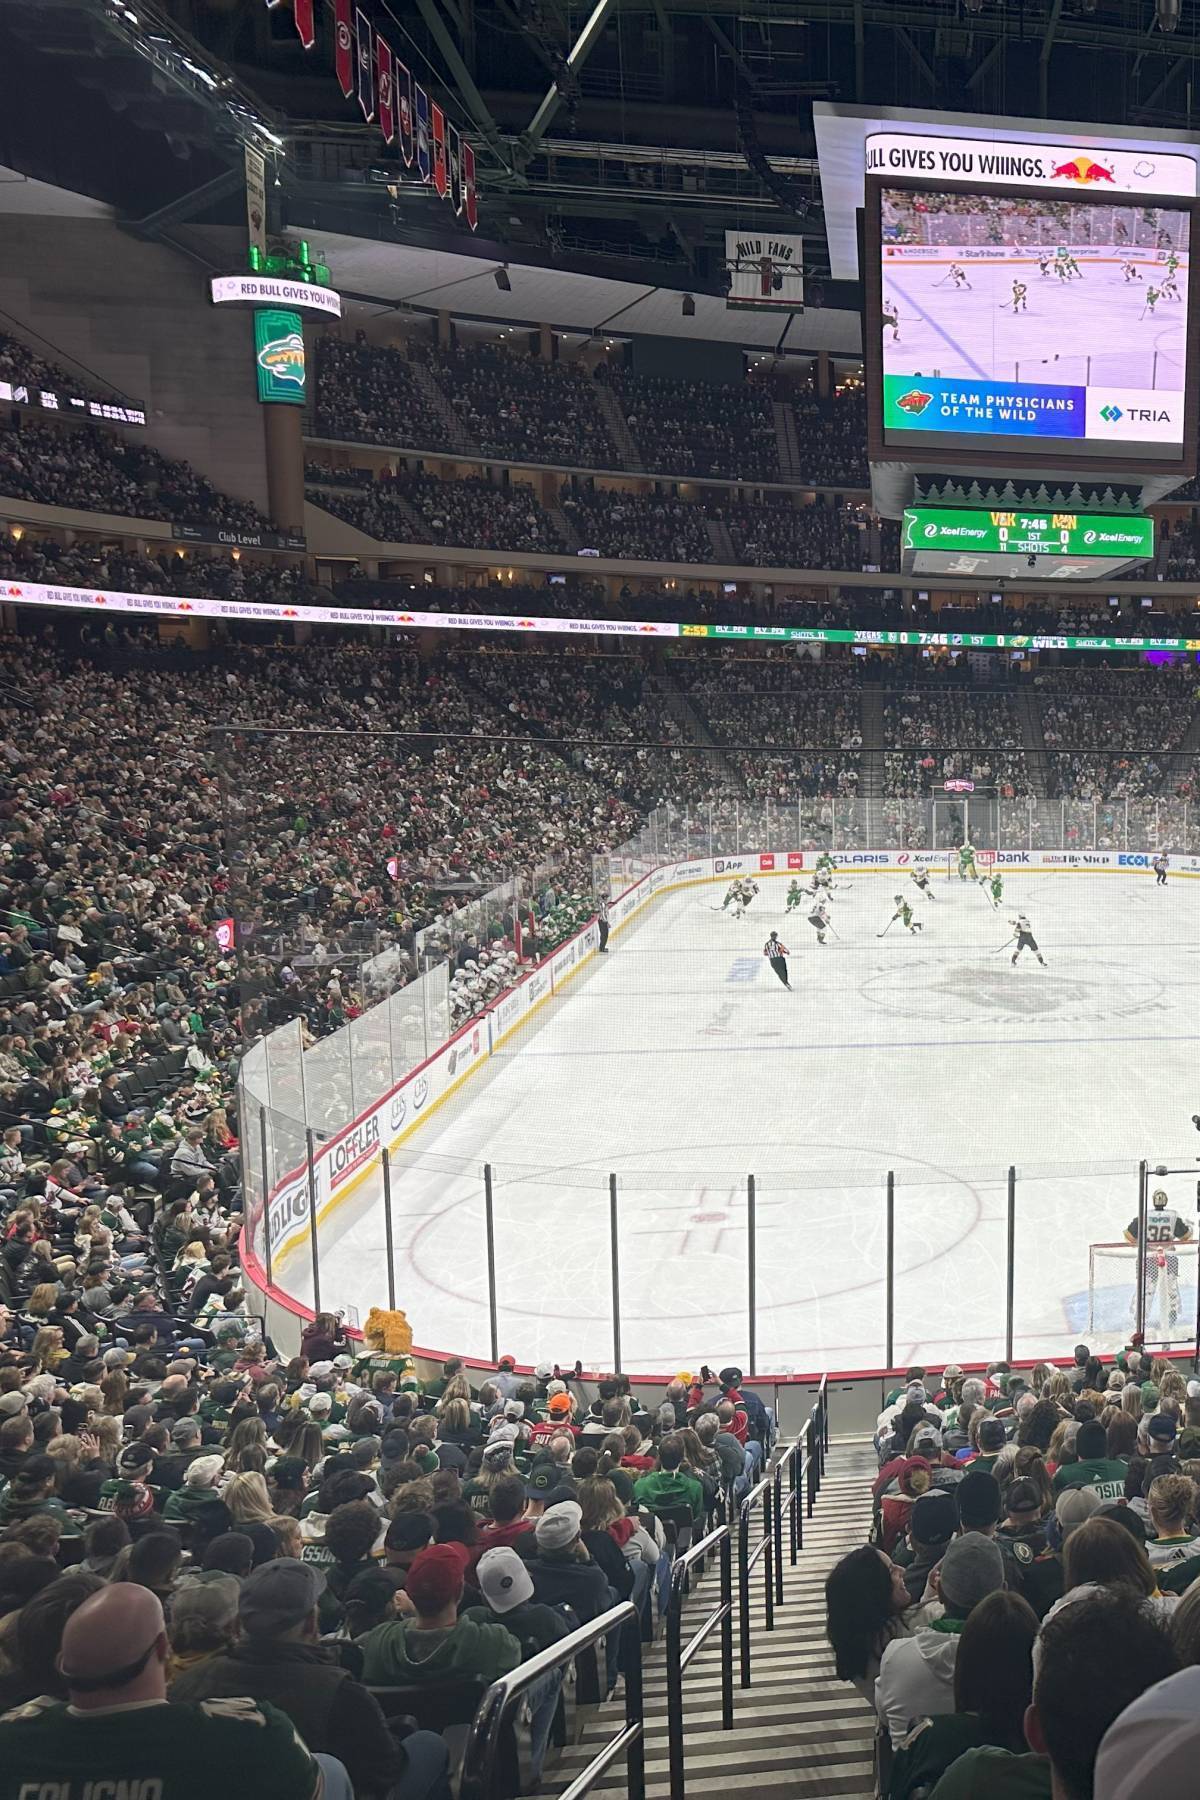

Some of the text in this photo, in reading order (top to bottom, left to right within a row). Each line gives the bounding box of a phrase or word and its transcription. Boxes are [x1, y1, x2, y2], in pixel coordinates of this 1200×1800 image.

[867, 148, 1046, 178] ULL GIVES YOU WIIINGS.
[736, 241, 793, 260] WILD FANS
[241, 283, 324, 303] RED BULL GIVES YOU
[941, 393, 1074, 410] TEAM PHYSICIANS
[941, 407, 1036, 421] OF THE WILD
[1127, 409, 1170, 422] TRIA
[219, 532, 261, 545] Club Level
[999, 528, 1008, 542] 0
[1060, 531, 1069, 544] 0
[1018, 543, 1049, 552] SHOTS
[1061, 545, 1067, 553] 4
[791, 631, 812, 639] SHOTS
[901, 632, 907, 643] 0
[919, 633, 947, 644] 7:46
[971, 636, 984, 644] 1ST
[998, 635, 1004, 646] 0
[1033, 640, 1067, 648] WILD
[997, 852, 1029, 862] bank
[1084, 856, 1109, 864] Shop
[329, 1115, 379, 1179] LOFFLER
[1148, 1226, 1171, 1242] 36
[535, 1434, 550, 1444] SUT
[471, 1495, 490, 1508] KAP
